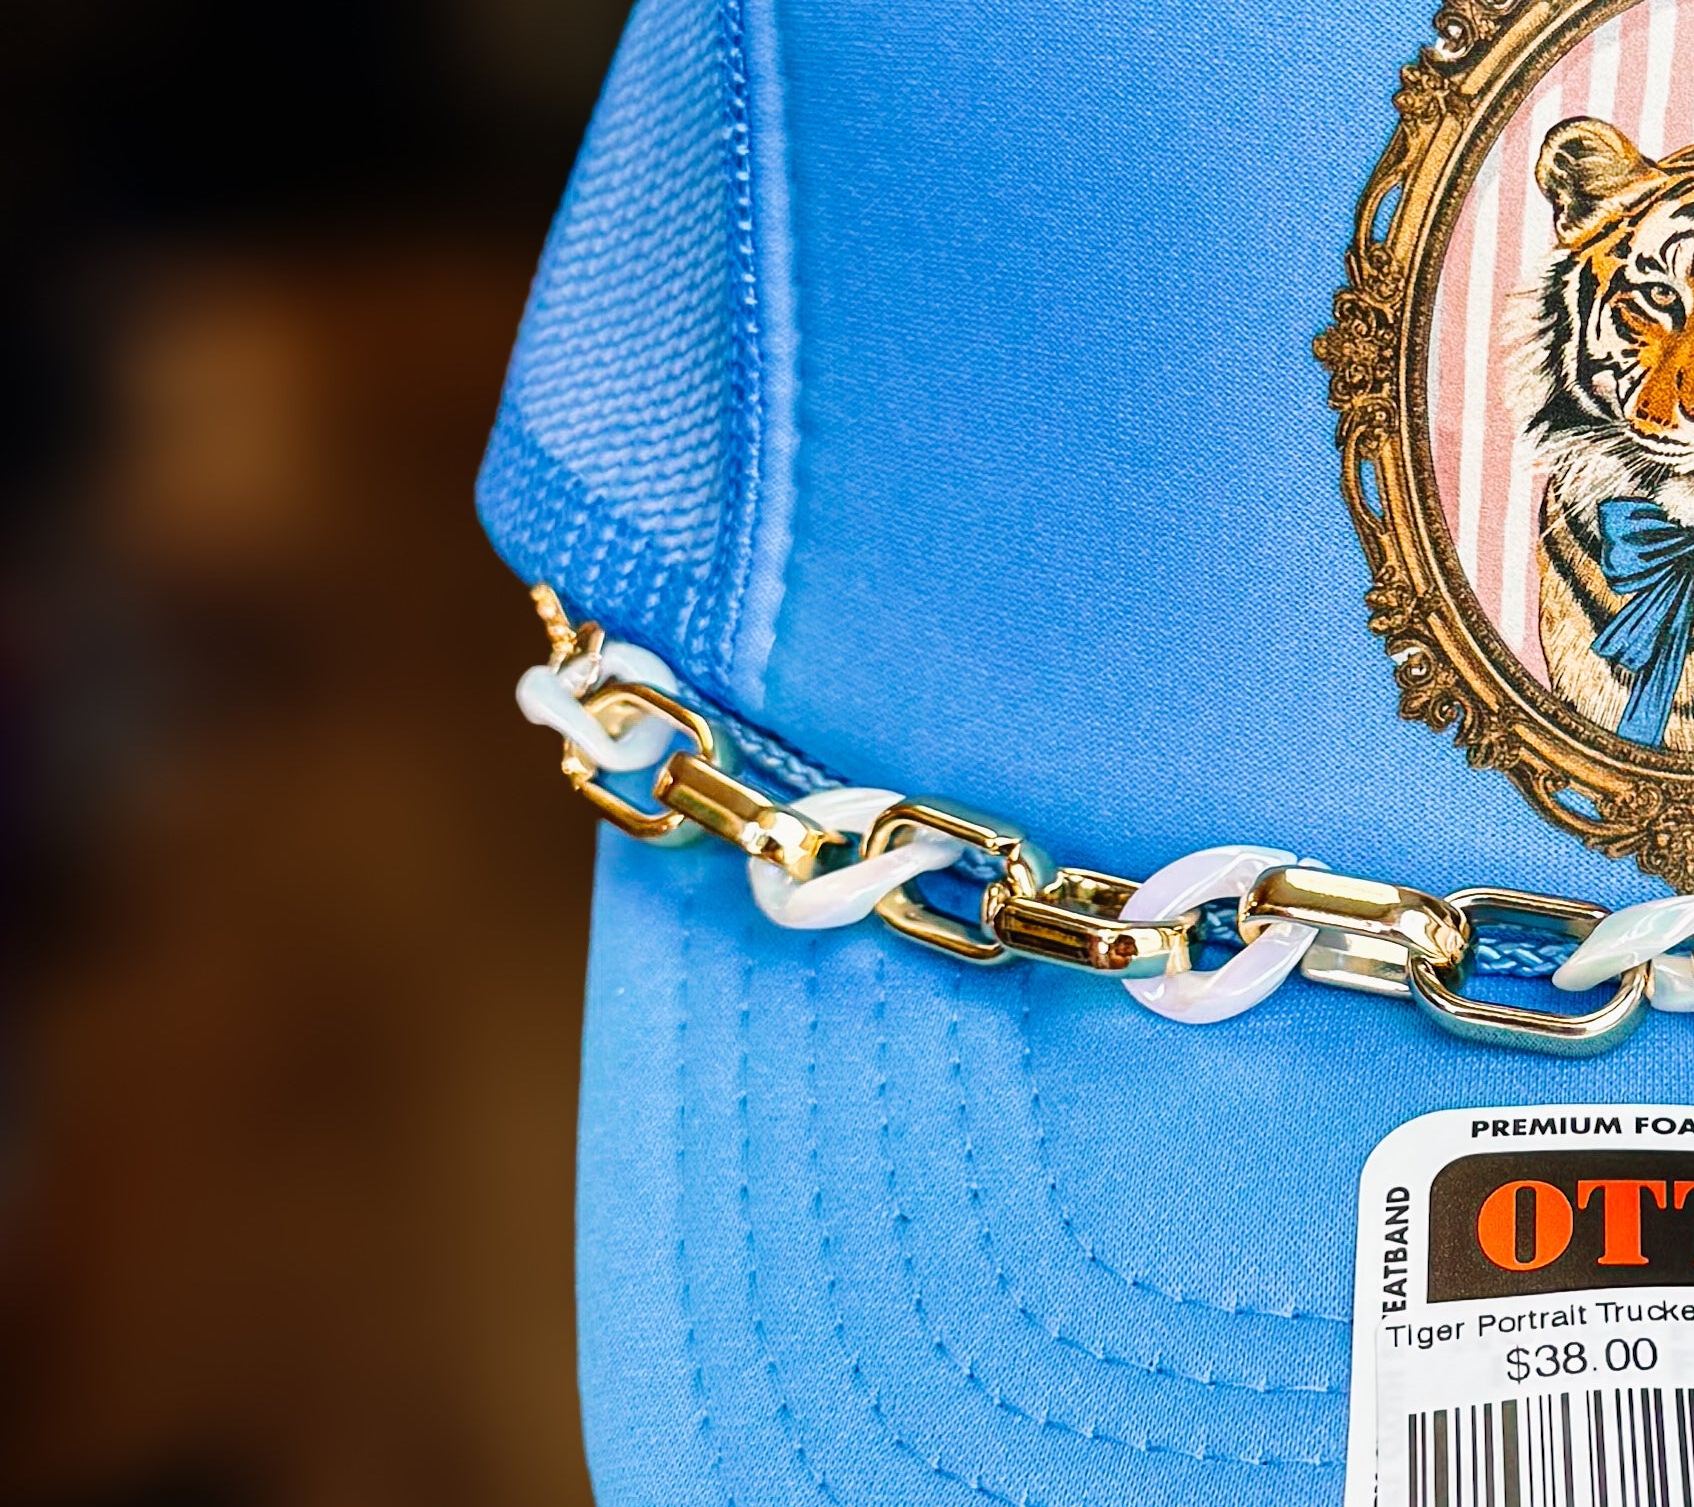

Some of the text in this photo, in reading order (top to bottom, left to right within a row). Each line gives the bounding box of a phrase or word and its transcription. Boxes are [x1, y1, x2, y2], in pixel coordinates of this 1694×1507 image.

[1471, 1116, 1622, 1139] PREMIUM
[1381, 1185, 1411, 1320] EATBAND
[1386, 1320, 1465, 1350] Tiger
[1478, 1303, 1588, 1337] Portrait
[1505, 1336, 1659, 1385] $38.00
